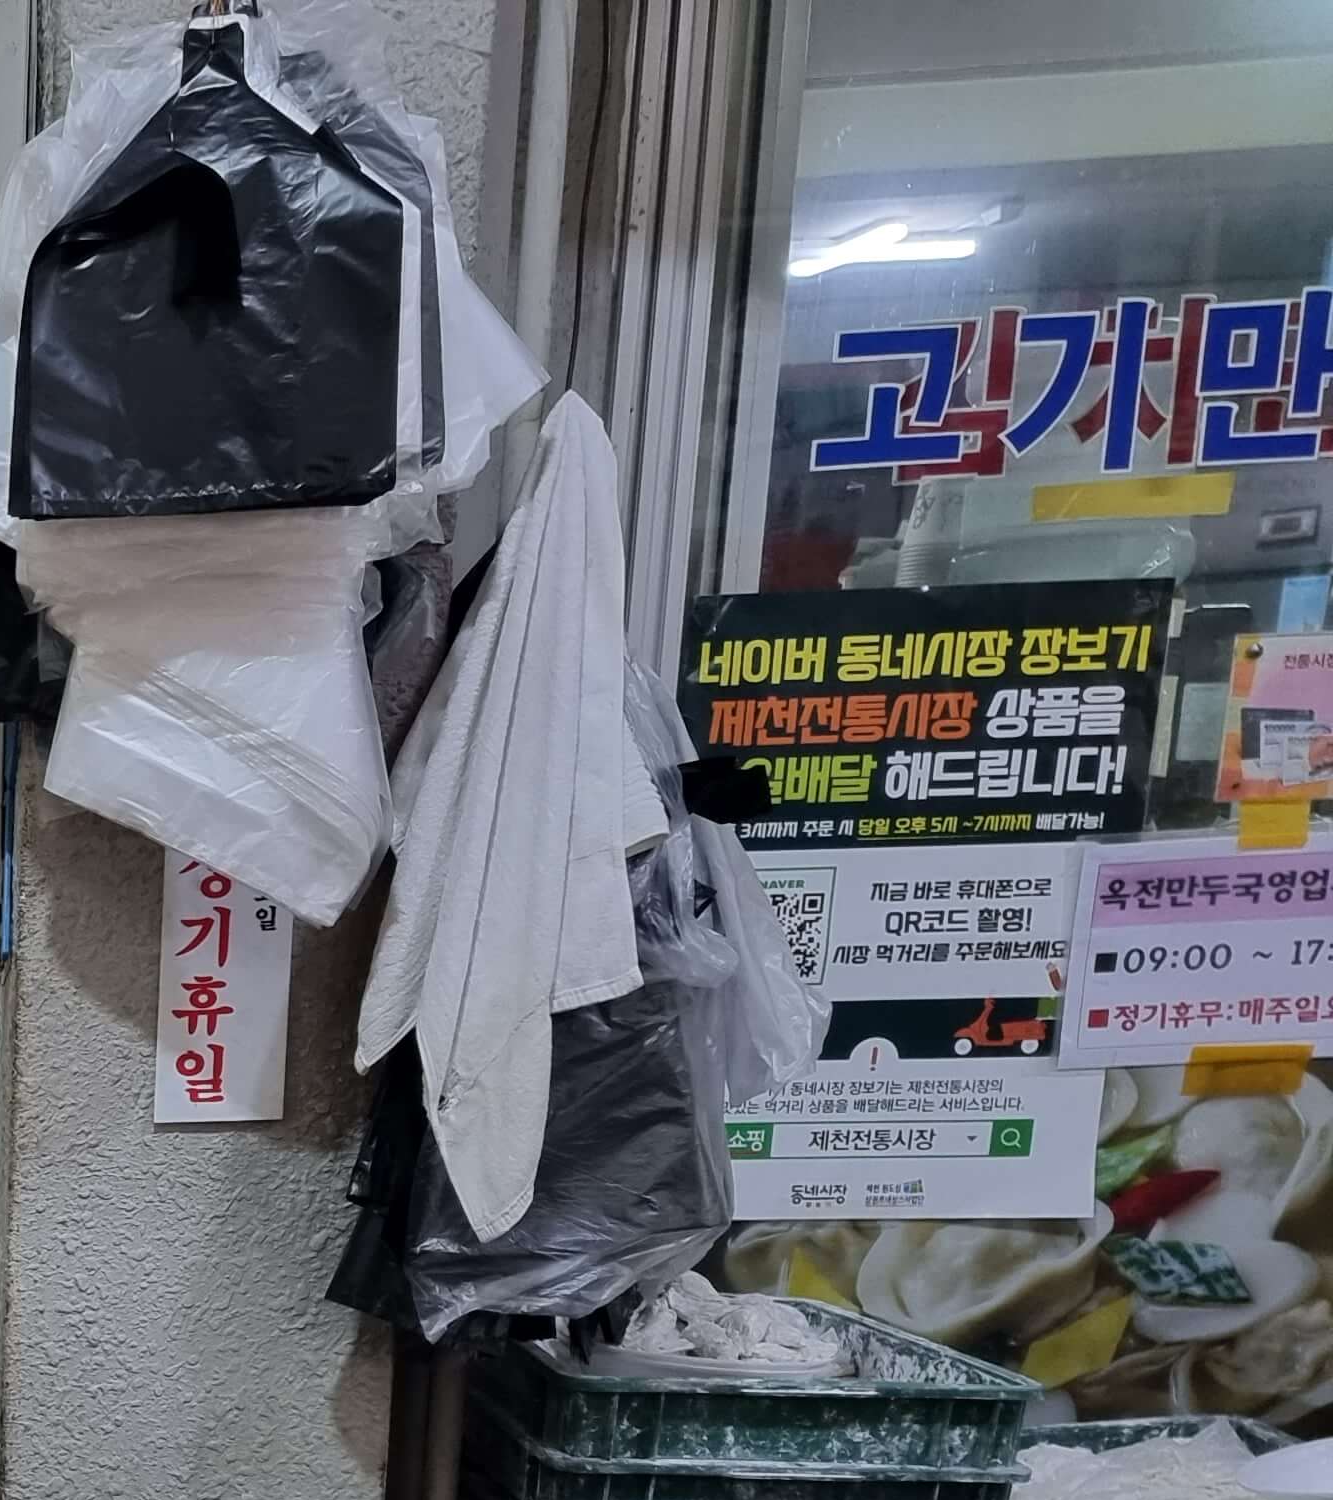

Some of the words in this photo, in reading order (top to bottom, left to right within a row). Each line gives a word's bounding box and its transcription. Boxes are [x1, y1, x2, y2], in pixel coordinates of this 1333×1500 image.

[699, 637, 826, 687] 네이버
[836, 630, 1013, 683] 동네시장
[1019, 625, 1152, 676] 장보기
[1284, 654, 1333, 669] 전통시
[709, 690, 977, 747] 제천전통시장
[985, 685, 1127, 739] 상품을
[884, 745, 1127, 801] 해드립니다!
[739, 820, 798, 840] 3시까지
[802, 819, 835, 838] 주문
[837, 819, 854, 837] 시
[858, 817, 891, 837] 당일
[894, 816, 927, 835] 오후
[930, 815, 958, 834] 5시
[1035, 812, 1104, 832] 배달가능!
[760, 879, 805, 890] NAVER
[870, 883, 908, 901] 지금
[913, 881, 951, 900] 바로
[956, 878, 1052, 899] 휴대폰으로
[1099, 868, 1333, 911] 옥전만두국영업
[885, 910, 969, 936] QR코드
[977, 908, 1032, 933] 촬영!
[833, 945, 870, 964] 시장
[955, 940, 1068, 961] 주문해보세요
[1122, 942, 1232, 975] 09:00
[790, 1081, 845, 1097] 동네시장
[848, 1080, 902, 1096] 장보기는
[907, 1079, 1003, 1095] 제천전통시장의
[764, 1099, 804, 1113] 먹거리
[807, 1098, 847, 1113] 상품을
[853, 1097, 934, 1112] 배달해드리는
[728, 1129, 765, 1150] 쇼핑
[808, 1129, 936, 1151] 제천전통시장
